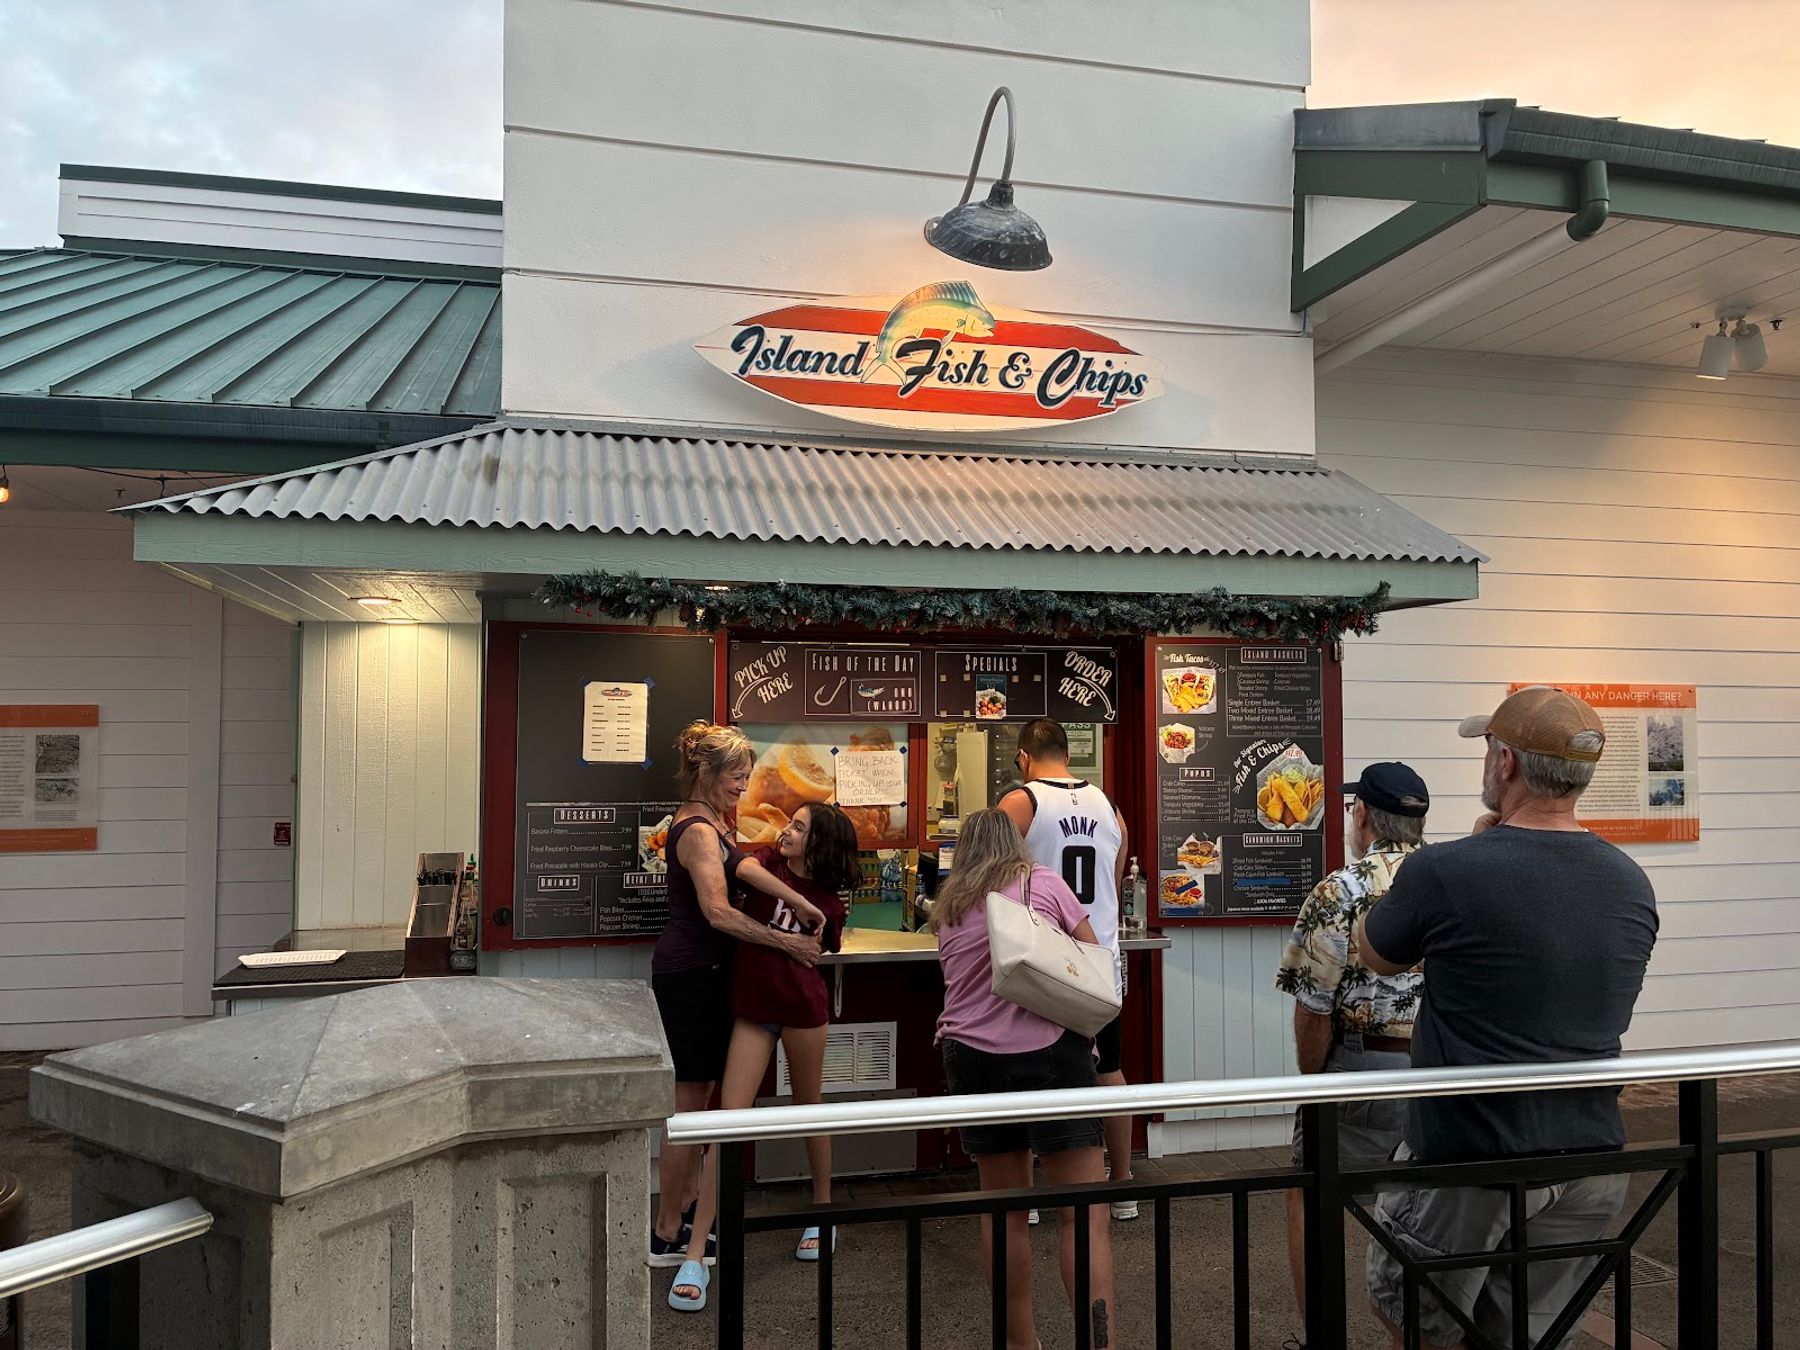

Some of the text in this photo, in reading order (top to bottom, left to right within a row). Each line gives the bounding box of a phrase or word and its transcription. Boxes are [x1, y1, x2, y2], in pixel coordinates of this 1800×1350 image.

[731, 325, 1148, 407] Island Fish & Chips
[734, 645, 787, 688] PICK UP
[812, 653, 914, 673] FISH OF THE DAY
[965, 654, 1017, 672] SPECIALS
[1170, 653, 1204, 663] Fish Tacos
[1064, 650, 1113, 688] ORDER
[756, 672, 794, 704] HERE
[1058, 677, 1097, 707] HERE
[1585, 691, 1606, 700] ANY
[1609, 691, 1650, 700] DANGER
[1653, 692, 1682, 701] HERE?
[1240, 739, 1267, 758] Signature
[838, 756, 898, 769] BRING BACK
[1235, 742, 1285, 788] Fish & Chips
[1184, 769, 1211, 778] PUPUS
[560, 810, 609, 820] DESSERTS
[1059, 816, 1098, 838] MONK
[541, 878, 577, 887] DRINKS
[1063, 845, 1095, 904] 0
